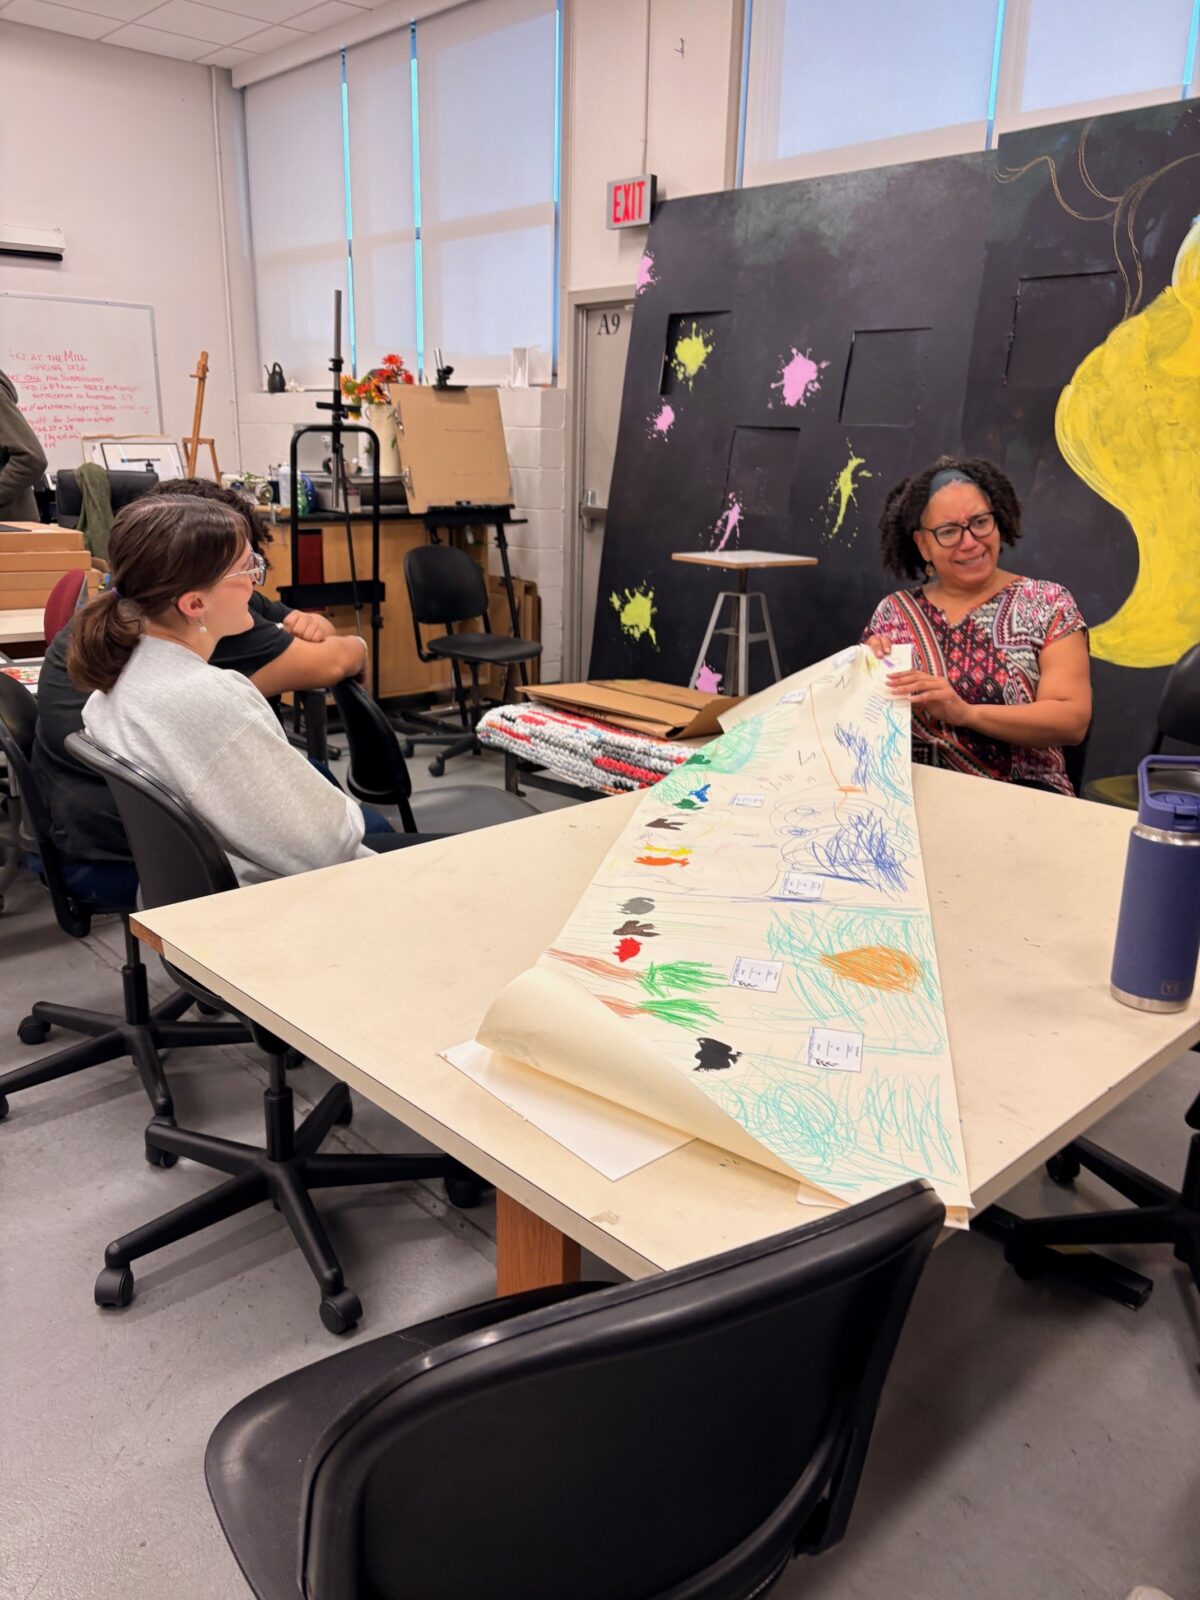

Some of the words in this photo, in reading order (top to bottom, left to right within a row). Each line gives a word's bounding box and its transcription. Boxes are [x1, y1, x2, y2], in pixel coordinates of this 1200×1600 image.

[612, 180, 646, 223] EXIT
[597, 313, 621, 335] A9
[47, 353, 63, 362] THE
